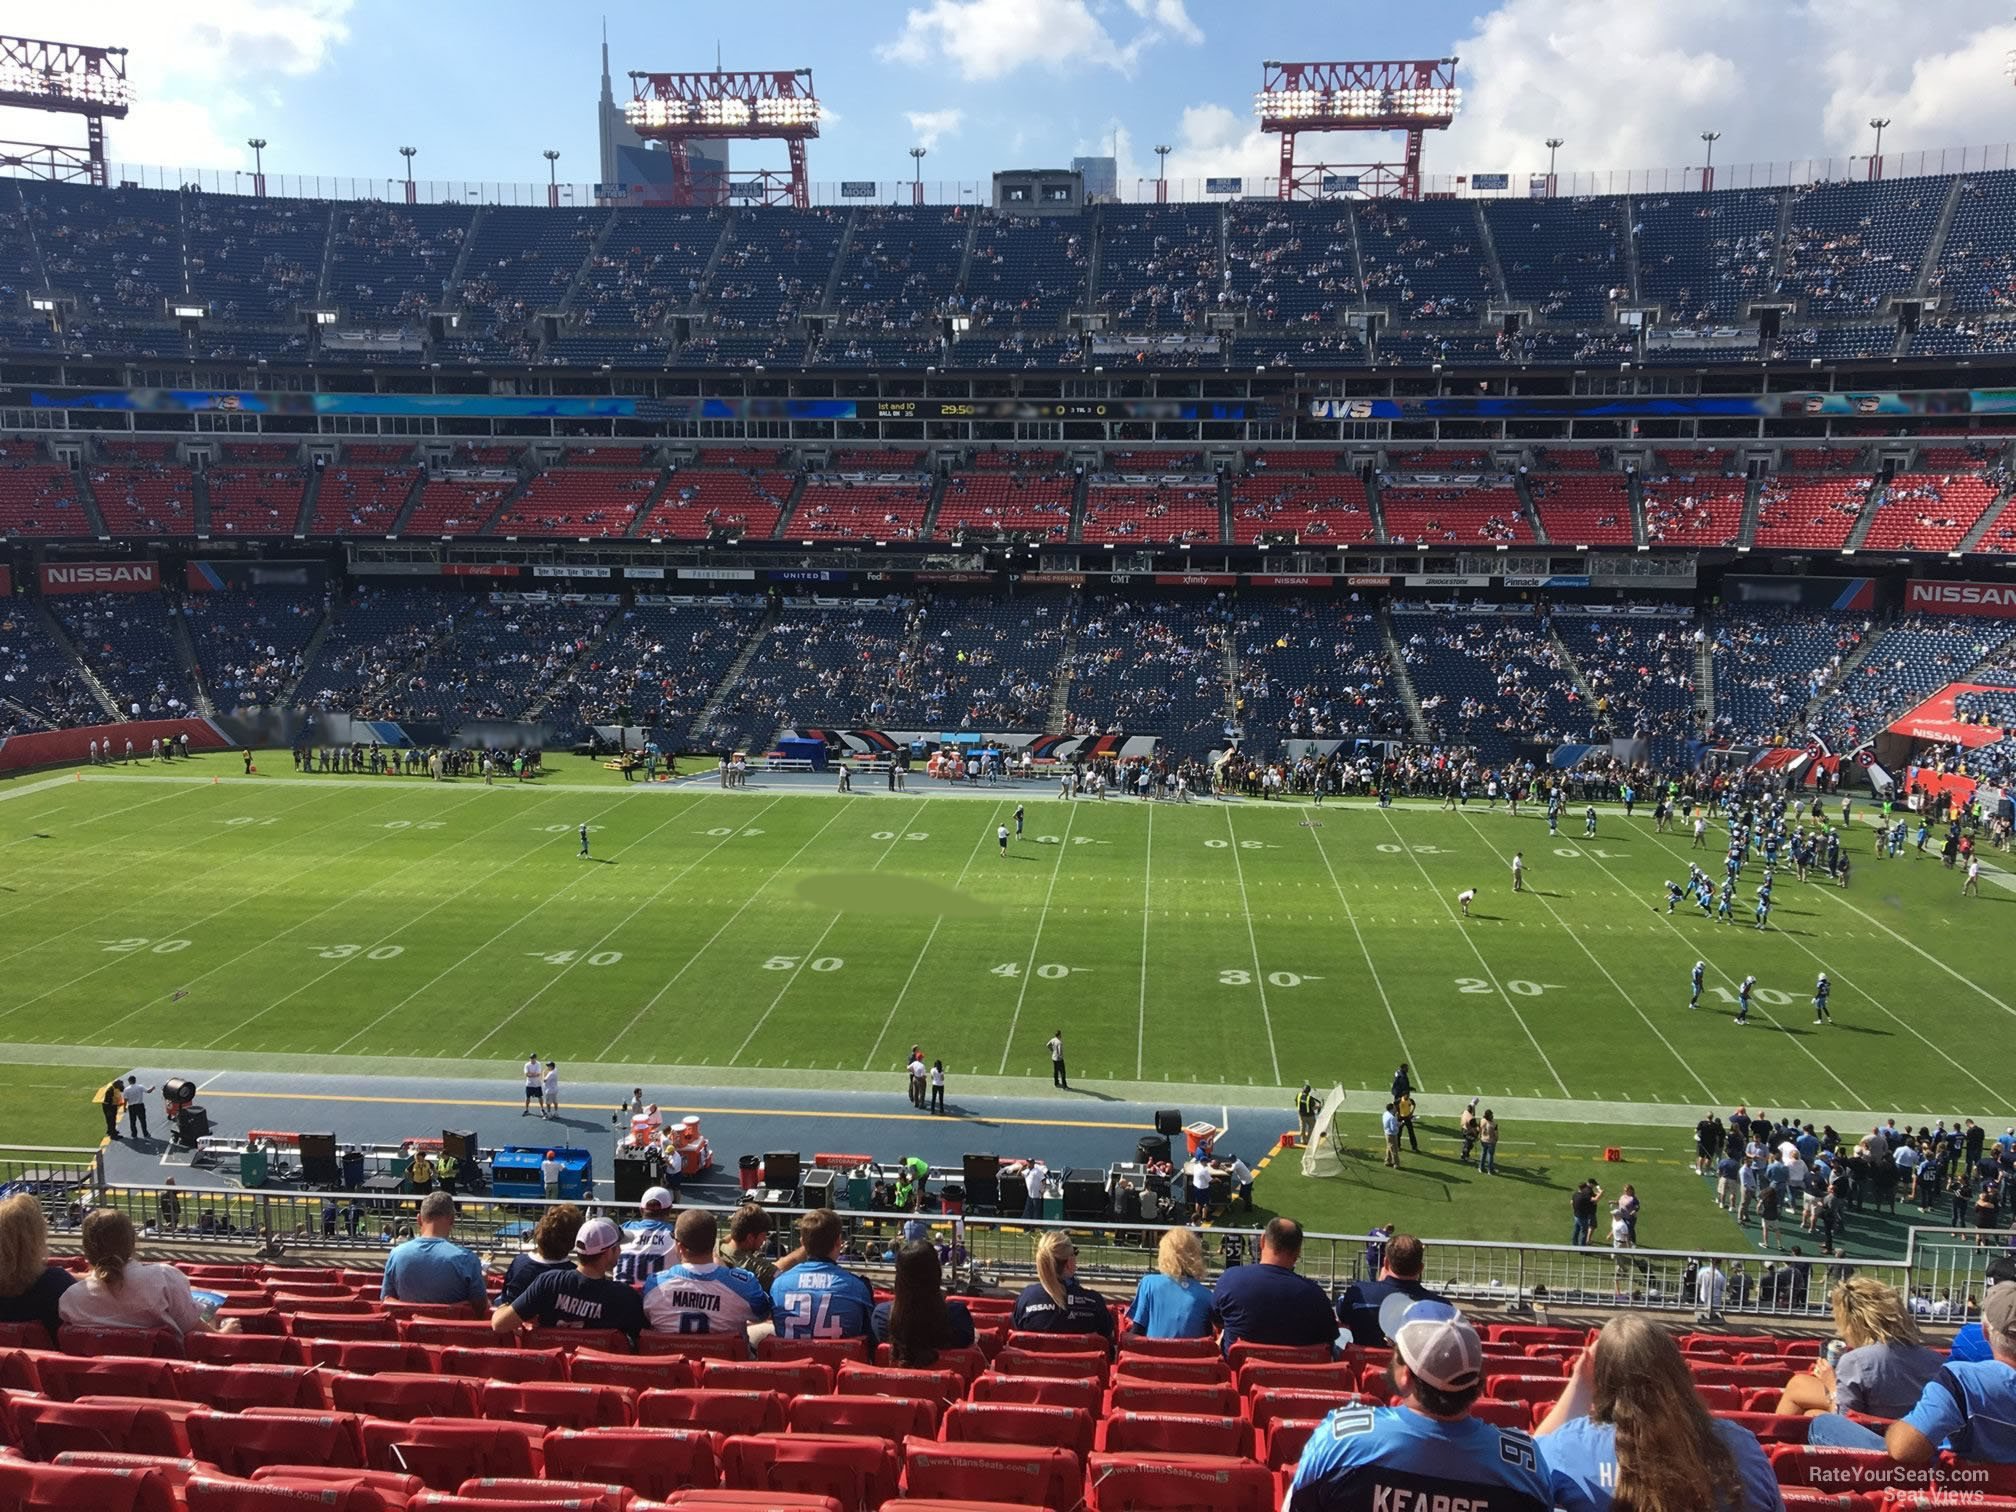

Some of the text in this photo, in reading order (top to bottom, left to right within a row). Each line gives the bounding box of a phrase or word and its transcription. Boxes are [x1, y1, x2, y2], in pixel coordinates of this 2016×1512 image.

[1324, 183, 1358, 191] NORTON
[48, 567, 154, 583] NISSAN
[867, 572, 893, 581] FedEx
[1110, 575, 1131, 584] CMT
[1183, 576, 1209, 584] xfinity
[1505, 577, 1540, 586] Pinnacle
[1912, 585, 2016, 605] NISSAN
[1912, 728, 1962, 743] NISSAN
[870, 831, 930, 841] 50
[1203, 838, 1263, 849] 30
[1375, 843, 1441, 855] 20
[101, 938, 193, 954] 20
[319, 944, 405, 961] 30
[544, 950, 624, 966] 40
[762, 956, 845, 972] 50
[990, 962, 1070, 979] 40
[1219, 970, 1303, 987] 30
[1453, 977, 1545, 996] 20
[1708, 986, 1793, 1005] 10
[1608, 1149, 1620, 1160] 20
[798, 1272, 834, 1289] HENRY
[555, 1293, 603, 1319] MARIOTA
[673, 1291, 721, 1312] MARIOTA
[1025, 1303, 1056, 1313] NISSAN
[784, 1293, 843, 1340] 24
[1137, 1415, 1223, 1427] www.TitansSeats.com
[928, 1456, 1026, 1472] www.TitansSeats.com
[1115, 1463, 1215, 1482] www.TitansSeats.com
[209, 1482, 320, 1502] www.TitansSeats.com
